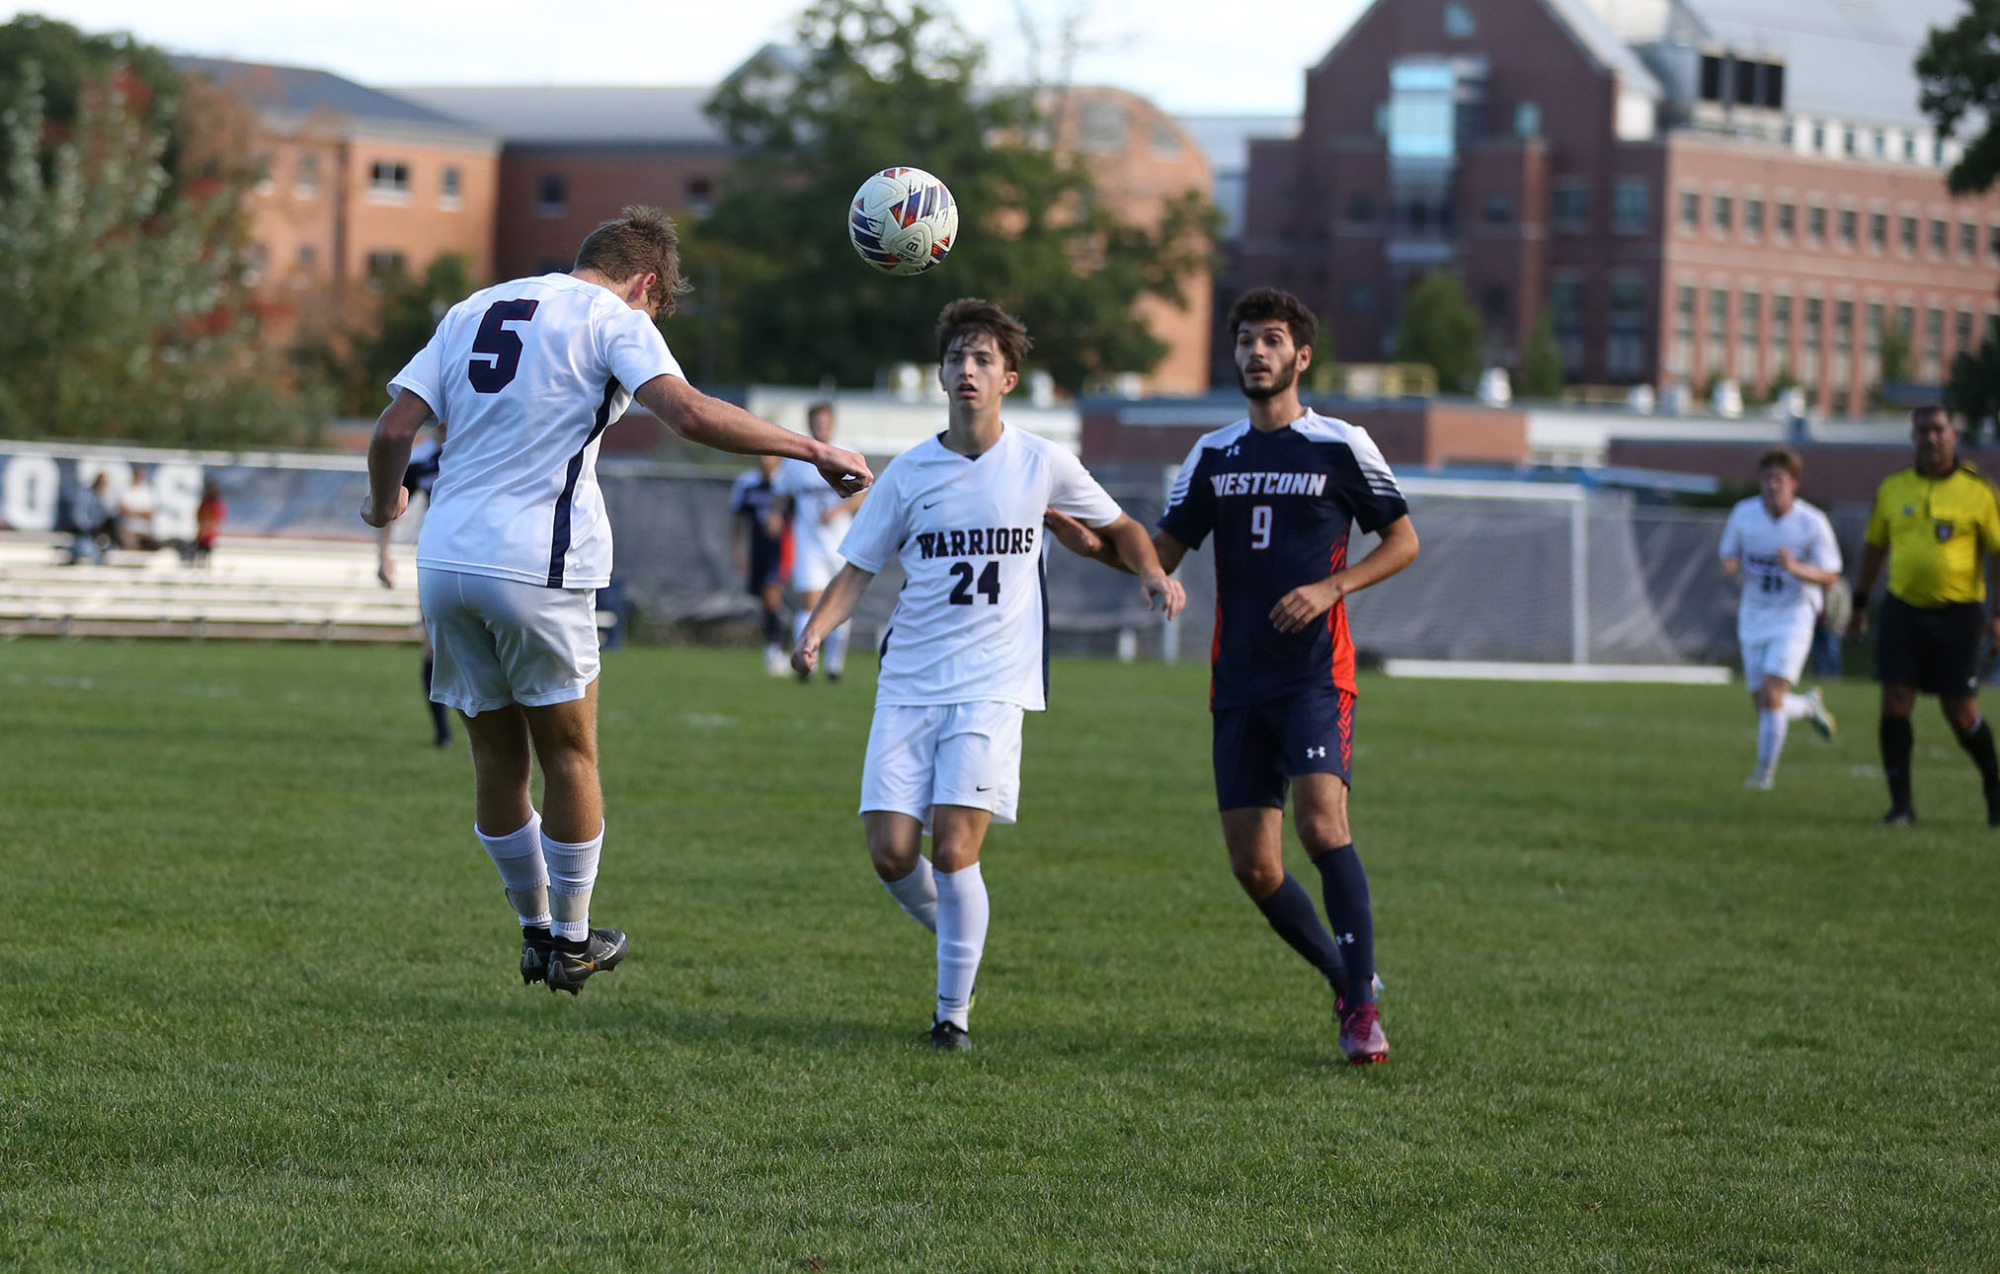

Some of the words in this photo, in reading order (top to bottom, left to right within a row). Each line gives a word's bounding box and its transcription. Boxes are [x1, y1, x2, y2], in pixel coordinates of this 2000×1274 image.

[468, 298, 540, 394] 5
[1210, 472, 1327, 497] WESTCONN
[916, 527, 1034, 560] WARRIORS
[1251, 505, 1272, 550] 9
[949, 561, 1001, 605] 24
